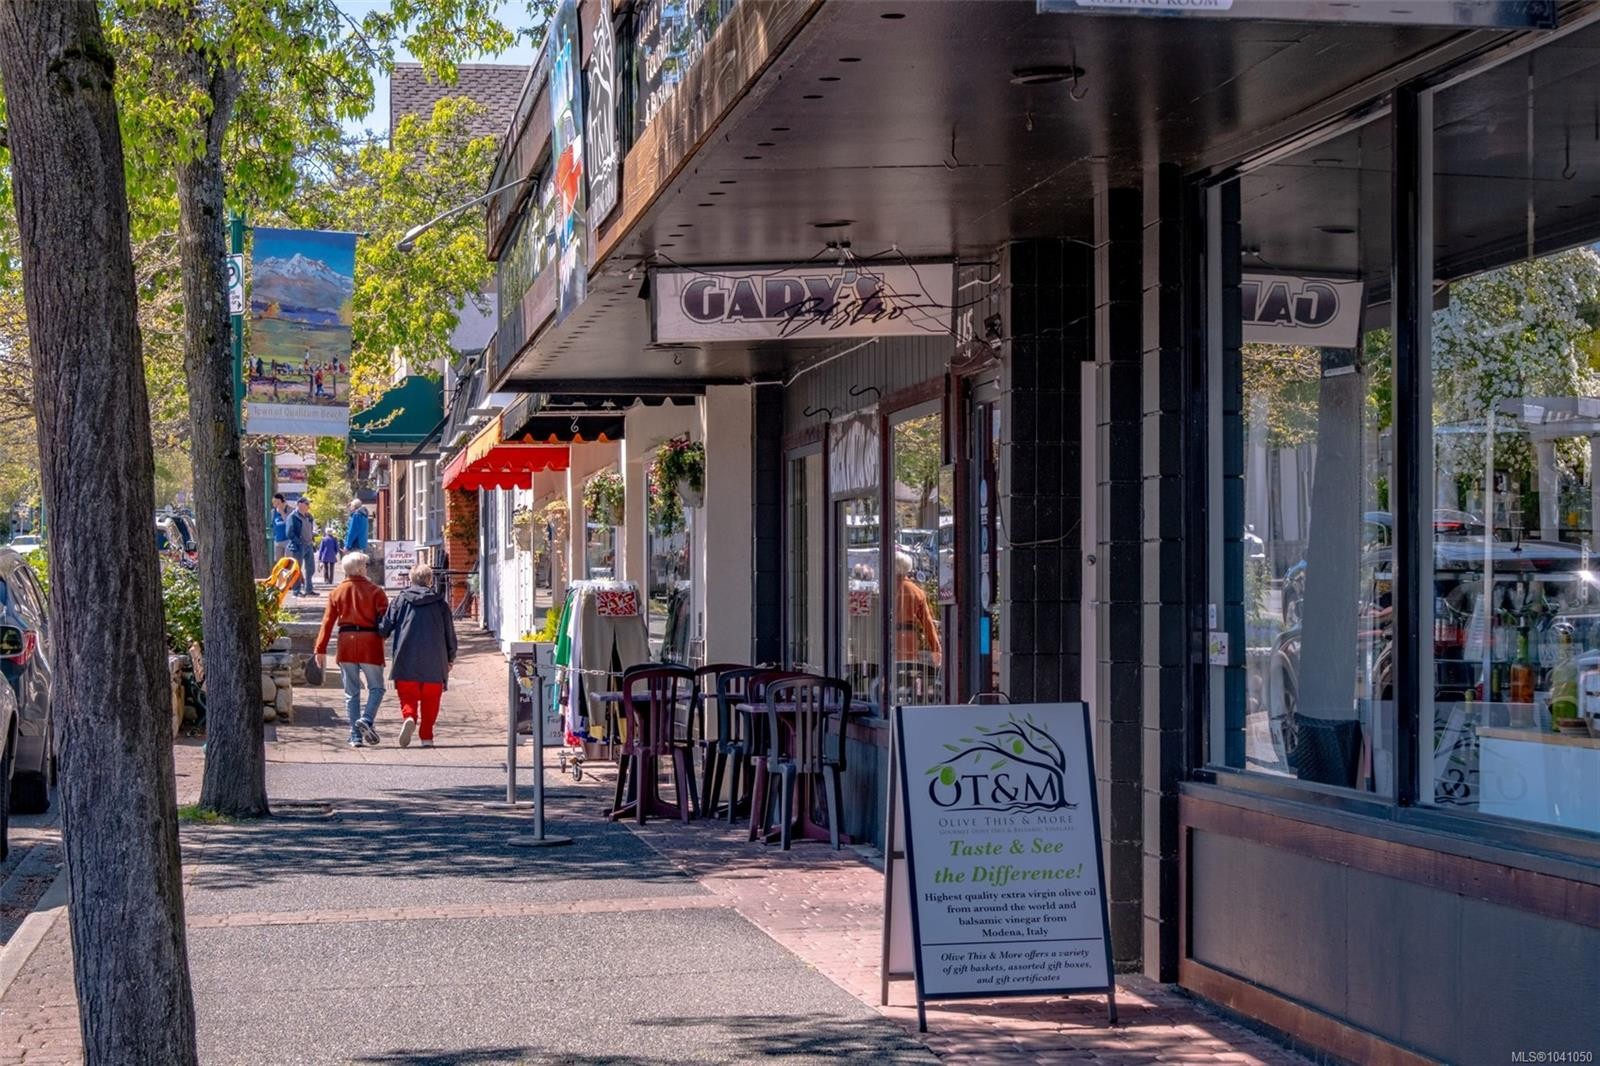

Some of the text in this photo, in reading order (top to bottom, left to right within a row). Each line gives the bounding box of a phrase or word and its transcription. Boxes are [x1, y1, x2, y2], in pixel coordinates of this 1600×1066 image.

[253, 405, 273, 416] Town
[928, 772, 1057, 807] OT&M
[938, 815, 1073, 828] OLIVE THIS & MORE
[950, 837, 1064, 857] Taste & See
[934, 863, 1083, 887] the Difference!
[925, 888, 1097, 903] Highest quality extra virgin olive oil
[947, 901, 1077, 914] from around the world and
[959, 914, 1067, 926] balsamic vinegar from
[982, 927, 1049, 937] Modena, Italy
[940, 953, 965, 962] Olive
[968, 952, 987, 960] This
[988, 952, 997, 960] &
[999, 951, 1022, 960] More
[1024, 950, 1049, 960] offers
[1058, 949, 1090, 959] variety
[942, 961, 1092, 975] of gift baskets, assorted gift boxes,
[976, 974, 1061, 985] and gift certificates
